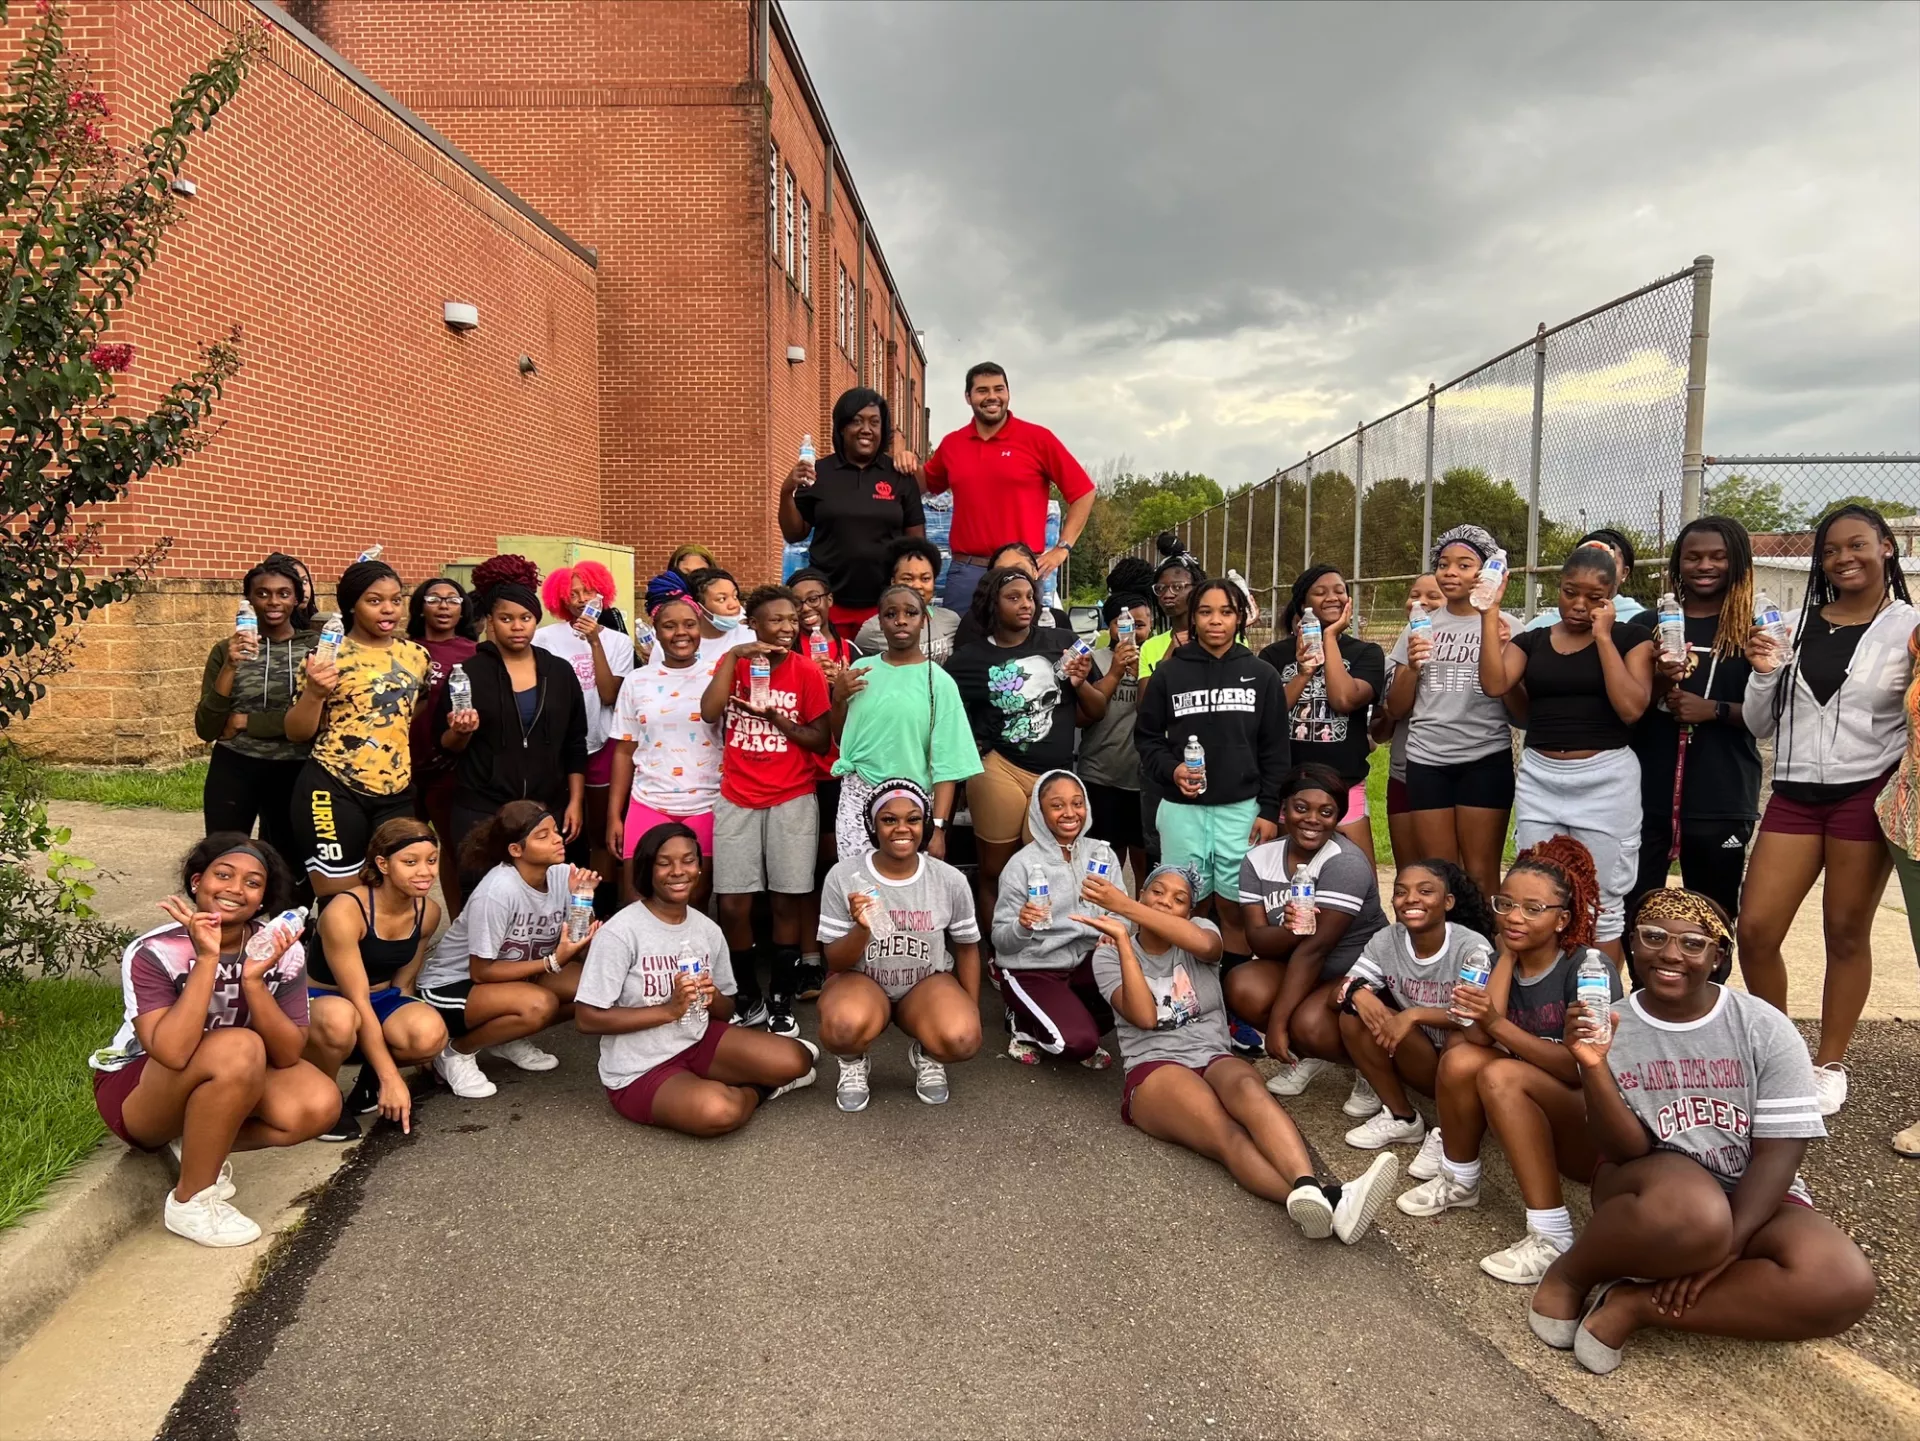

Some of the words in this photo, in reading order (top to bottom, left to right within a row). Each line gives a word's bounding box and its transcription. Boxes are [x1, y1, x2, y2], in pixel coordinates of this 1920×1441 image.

[1464, 632, 1481, 645] th
[1194, 688, 1257, 706] TIGERS
[311, 789, 338, 841] CURRY
[316, 843, 343, 860] 30
[865, 934, 930, 962] CHEER
[1680, 1058, 1709, 1089] HIGH
[1709, 1058, 1750, 1089] SCHOO
[1657, 1095, 1750, 1141] CHEER
